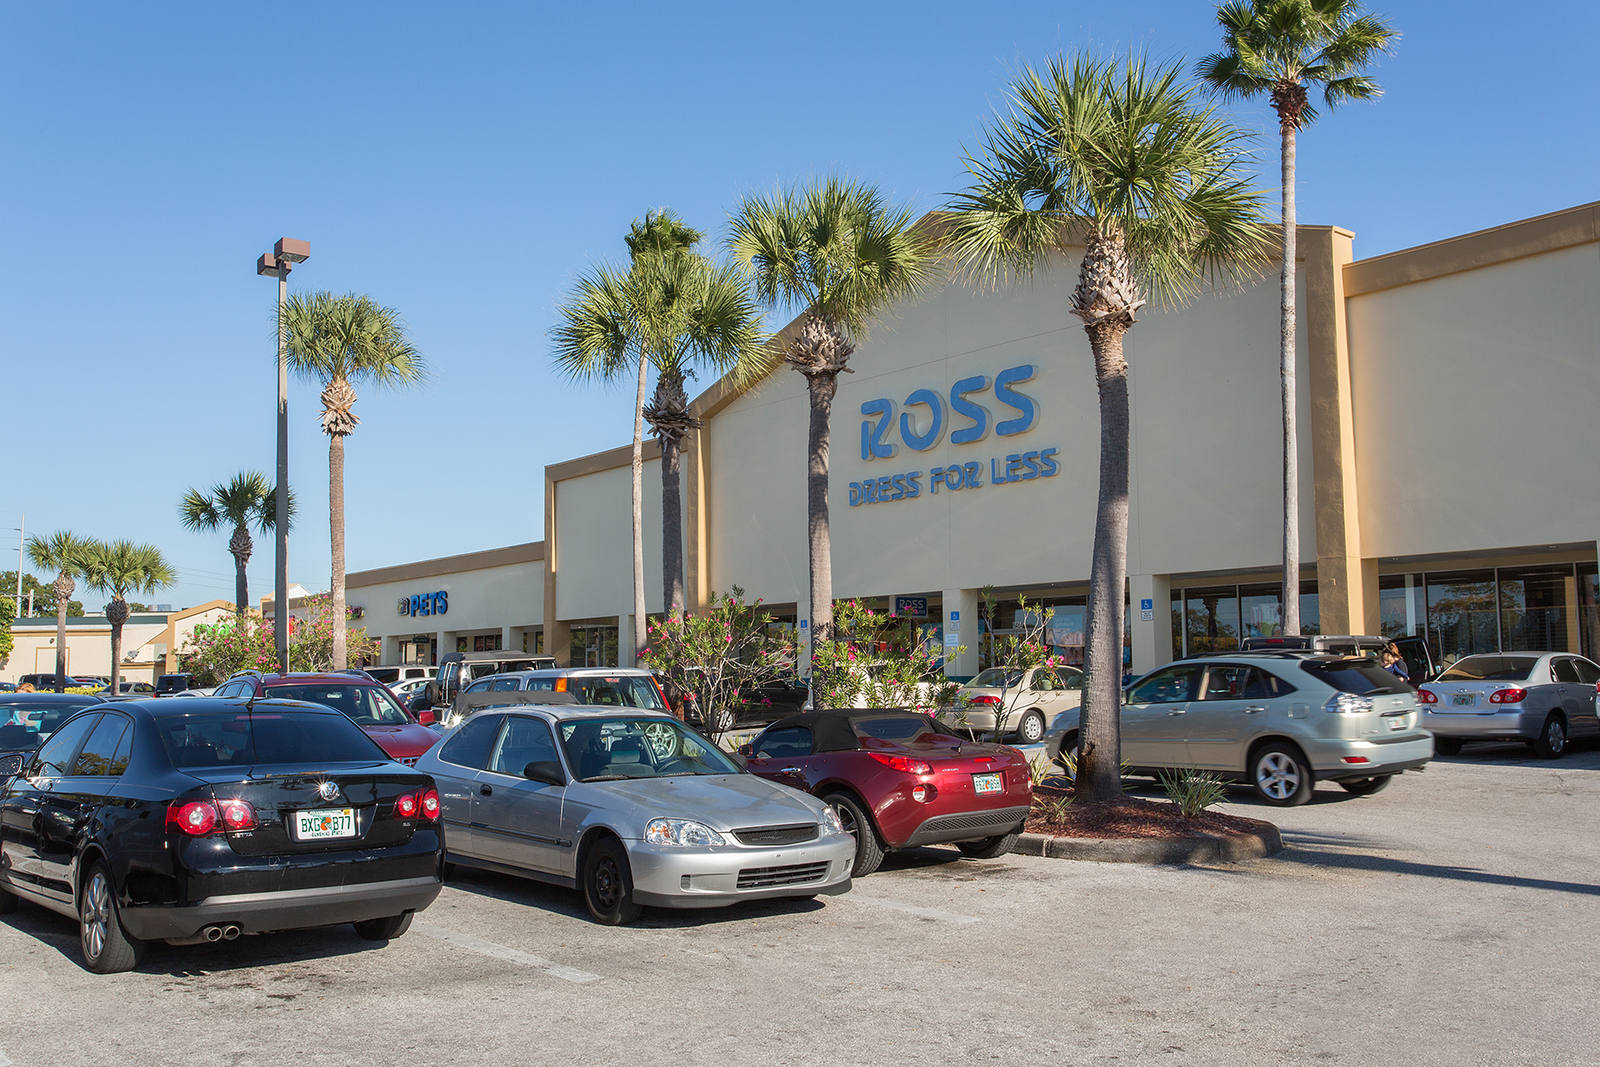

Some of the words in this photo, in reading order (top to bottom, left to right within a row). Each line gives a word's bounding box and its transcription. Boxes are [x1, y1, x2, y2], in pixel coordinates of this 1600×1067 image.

[860, 363, 1040, 461] ROSS
[848, 471, 922, 507] DRESS
[930, 461, 984, 494] FOR
[991, 447, 1062, 485] LESS
[410, 590, 449, 617] PETS
[899, 599, 924, 609] ROSS
[332, 815, 351, 831] B77
